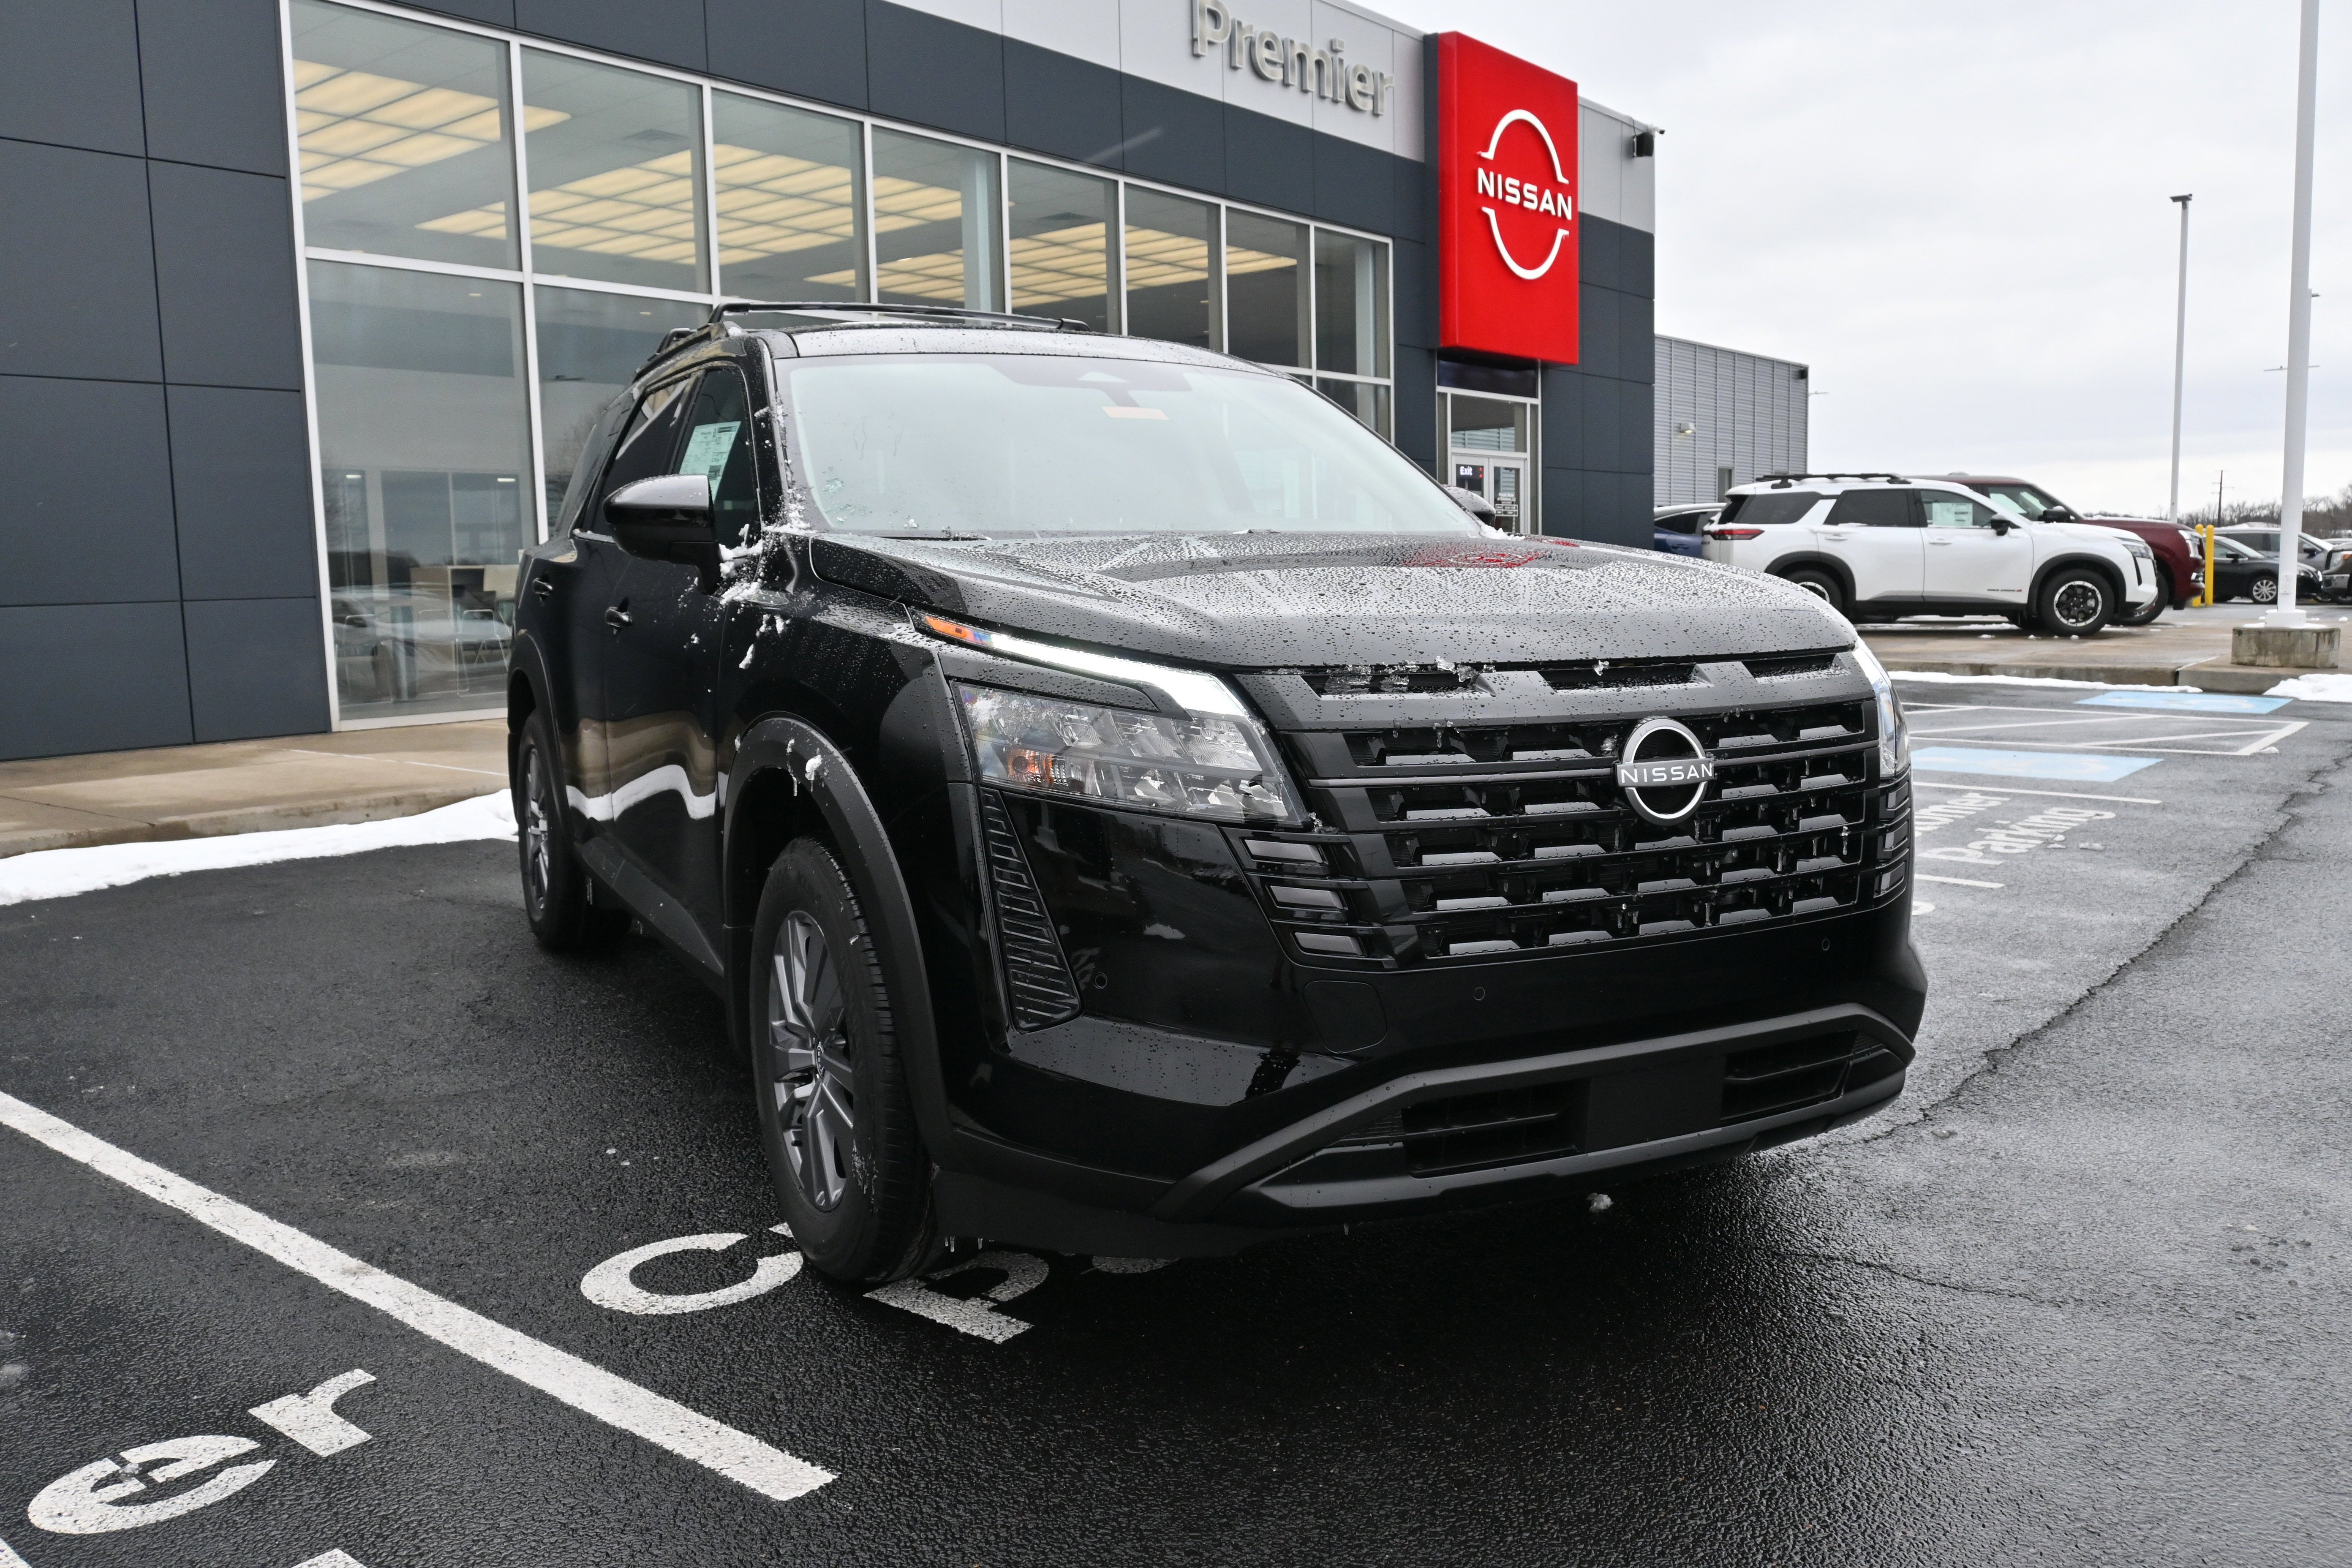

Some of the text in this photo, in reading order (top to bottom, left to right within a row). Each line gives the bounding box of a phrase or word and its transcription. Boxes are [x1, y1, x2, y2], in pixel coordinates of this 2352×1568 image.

[1191, 0, 1394, 116] Premier
[1478, 167, 1572, 220] NISSAN
[1460, 466, 1473, 476] Exit
[1621, 763, 1712, 783] NISSAN
[1916, 807, 2116, 865] Parking
